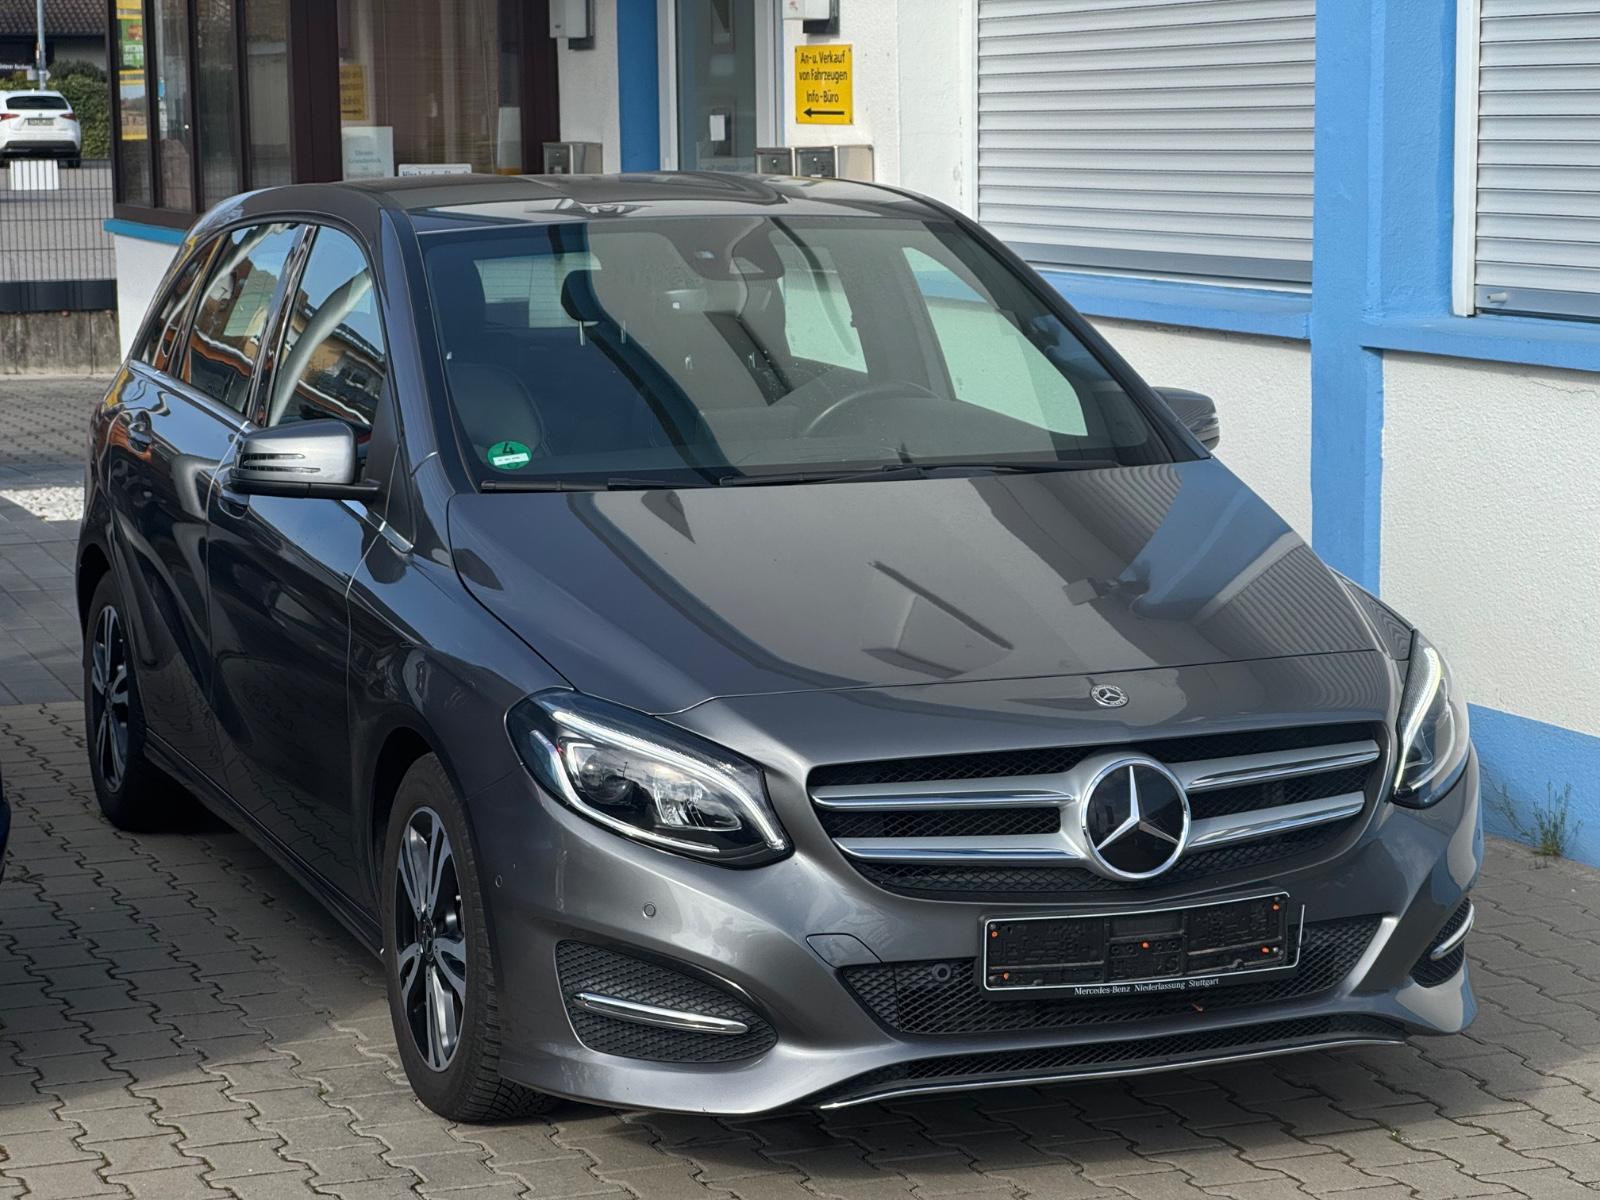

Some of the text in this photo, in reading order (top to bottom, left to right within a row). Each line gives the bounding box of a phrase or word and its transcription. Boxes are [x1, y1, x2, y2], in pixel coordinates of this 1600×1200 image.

[819, 50, 845, 64] Verkauf
[799, 68, 848, 84] von Fahrzeugen
[503, 442, 515, 454] 4
[1074, 978, 1219, 995] Mercedes-Benz Niederlassung Stuttgart
